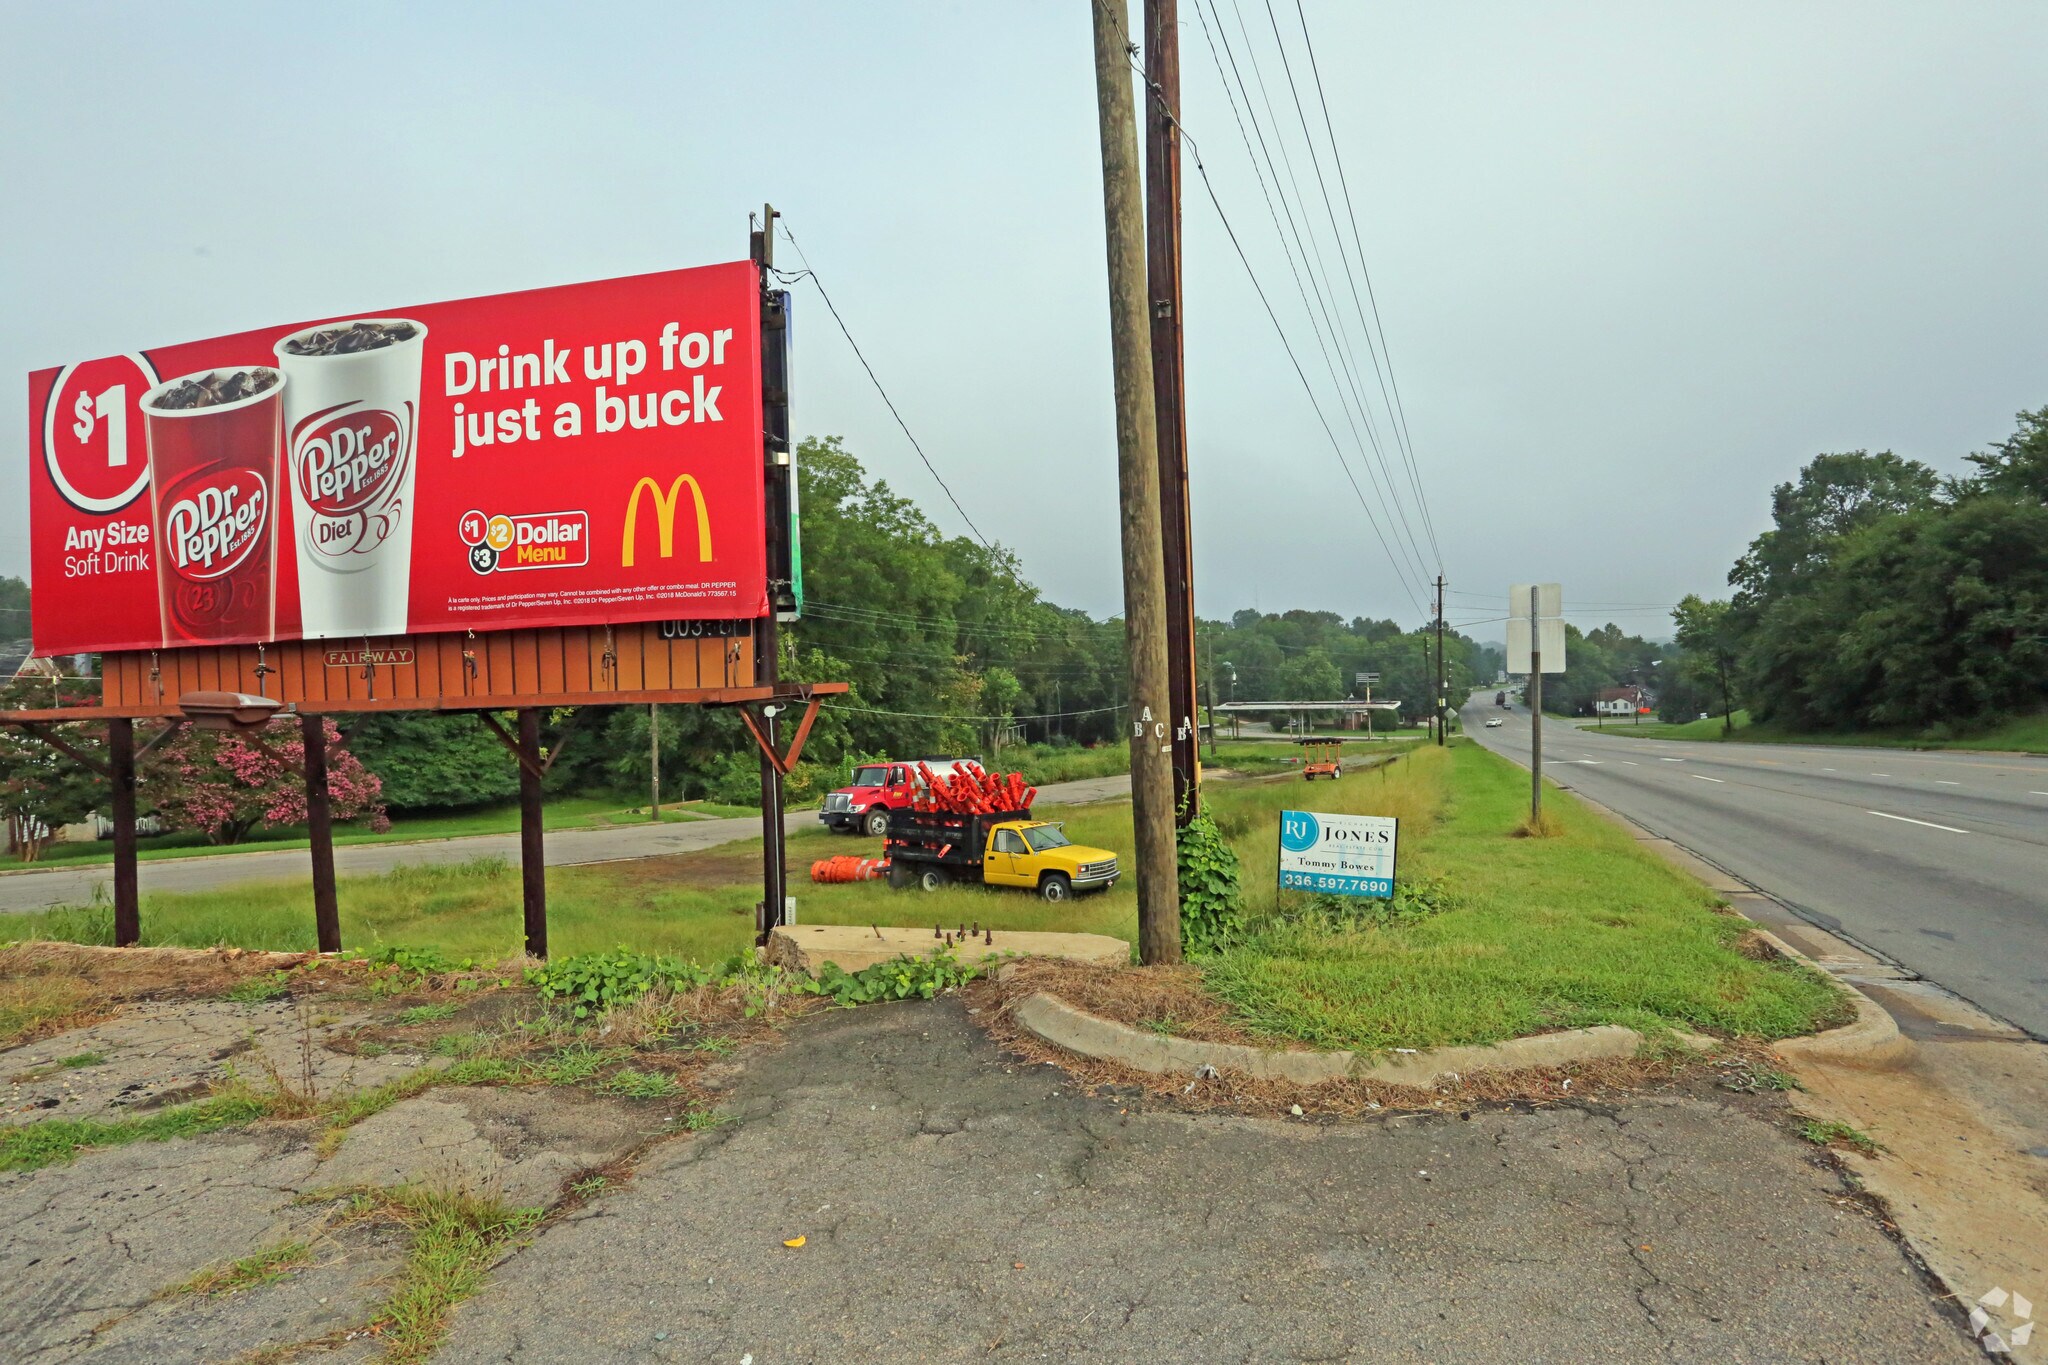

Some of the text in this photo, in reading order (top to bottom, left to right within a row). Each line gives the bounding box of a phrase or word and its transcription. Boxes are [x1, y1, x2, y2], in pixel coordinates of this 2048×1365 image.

[445, 321, 733, 396] Drink up for
[73, 383, 127, 467] $1
[452, 375, 724, 459] just a buck
[330, 425, 372, 468] Dr
[301, 431, 396, 503] Pepper
[197, 484, 239, 532] Dr
[64, 520, 149, 553] Any Size
[167, 489, 262, 569] Pepper
[319, 518, 352, 544] Diet
[464, 519, 479, 538] $1
[491, 523, 508, 543] $2
[516, 518, 582, 545] Dollar
[65, 548, 149, 578] Soft Drink
[473, 548, 491, 568] $3
[517, 544, 567, 564] Menu
[191, 585, 215, 612] 23
[507, 593, 535, 601] participation
[329, 651, 407, 664] FAIRWAY
[1141, 705, 1153, 722] A
[1183, 716, 1192, 730] A
[1133, 721, 1143, 737] B
[1155, 722, 1165, 738] C
[1177, 727, 1187, 741] B
[1285, 820, 1307, 840] RJ
[1325, 826, 1389, 844] JONES
[1297, 856, 1375, 871] Tommy Bowes
[1285, 874, 1388, 892] 336.597.7690
